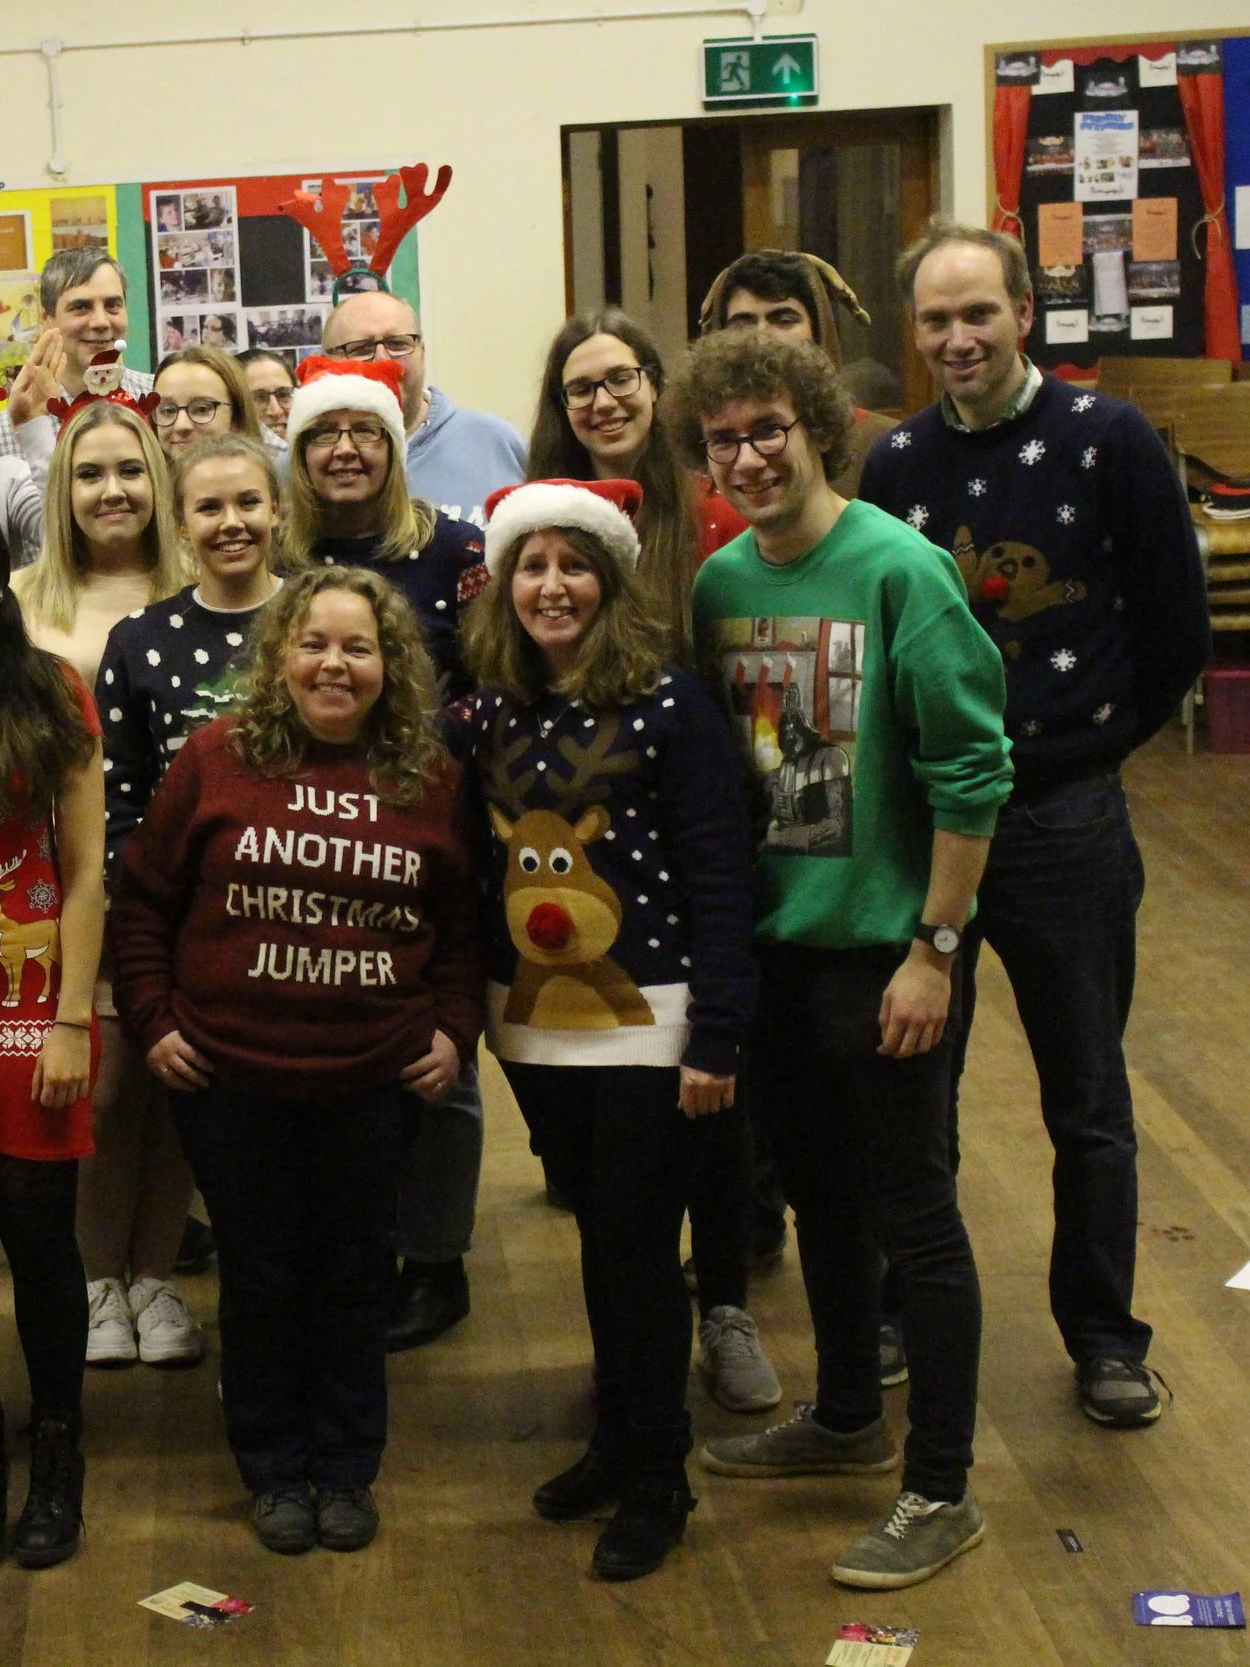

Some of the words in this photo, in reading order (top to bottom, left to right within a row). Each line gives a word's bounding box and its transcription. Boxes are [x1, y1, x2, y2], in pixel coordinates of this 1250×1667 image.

[287, 784, 380, 822] JUST
[235, 826, 421, 887] ANOTHER
[226, 883, 420, 933] CHRISTMAS
[247, 943, 398, 986] JUMPER
